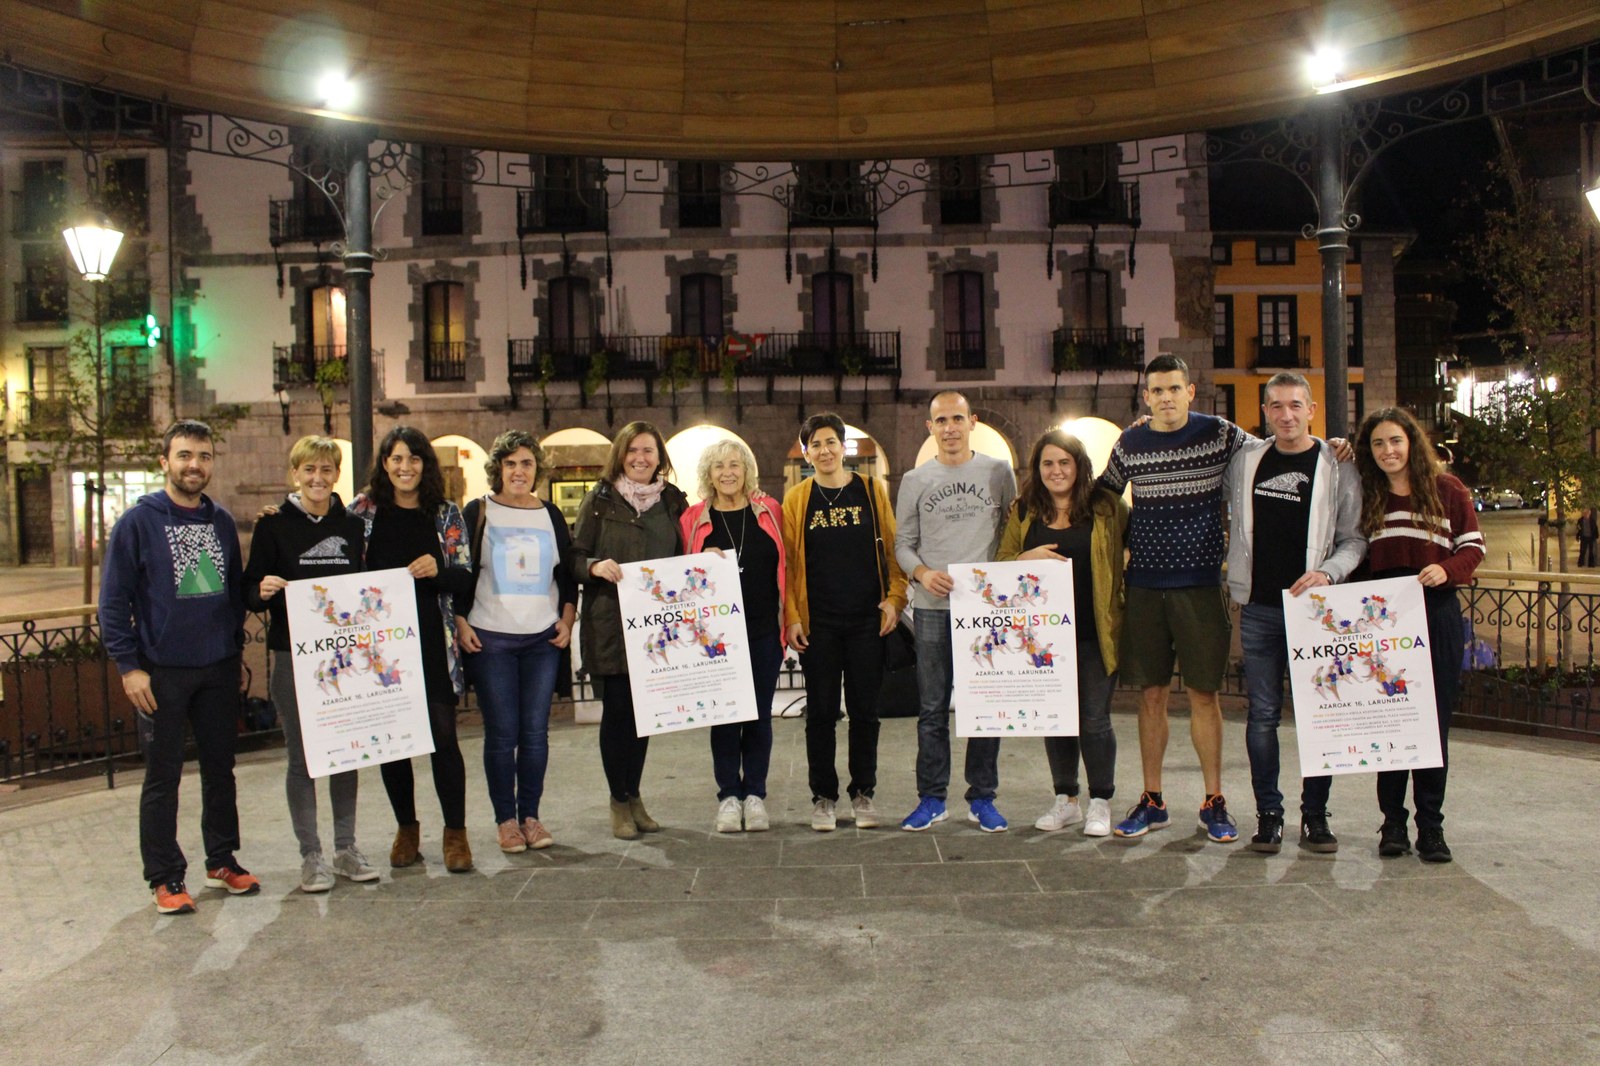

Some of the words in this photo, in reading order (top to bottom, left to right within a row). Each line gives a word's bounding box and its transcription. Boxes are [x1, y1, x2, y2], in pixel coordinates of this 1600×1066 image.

[924, 482, 995, 512] ORIGINALS
[809, 506, 862, 530] ART
[661, 601, 696, 612] AZPEITIKO
[333, 624, 371, 635] AZPEITIKO
[1332, 633, 1373, 643] AZPEITIKO
[651, 664, 679, 674] AZAROAK
[693, 658, 728, 668] LARUNBATA
[322, 696, 352, 706] AZAROAK
[367, 687, 403, 698] LARUNBATA
[1319, 702, 1351, 710] AZAROAK
[1368, 696, 1409, 706] LARUNBATA
